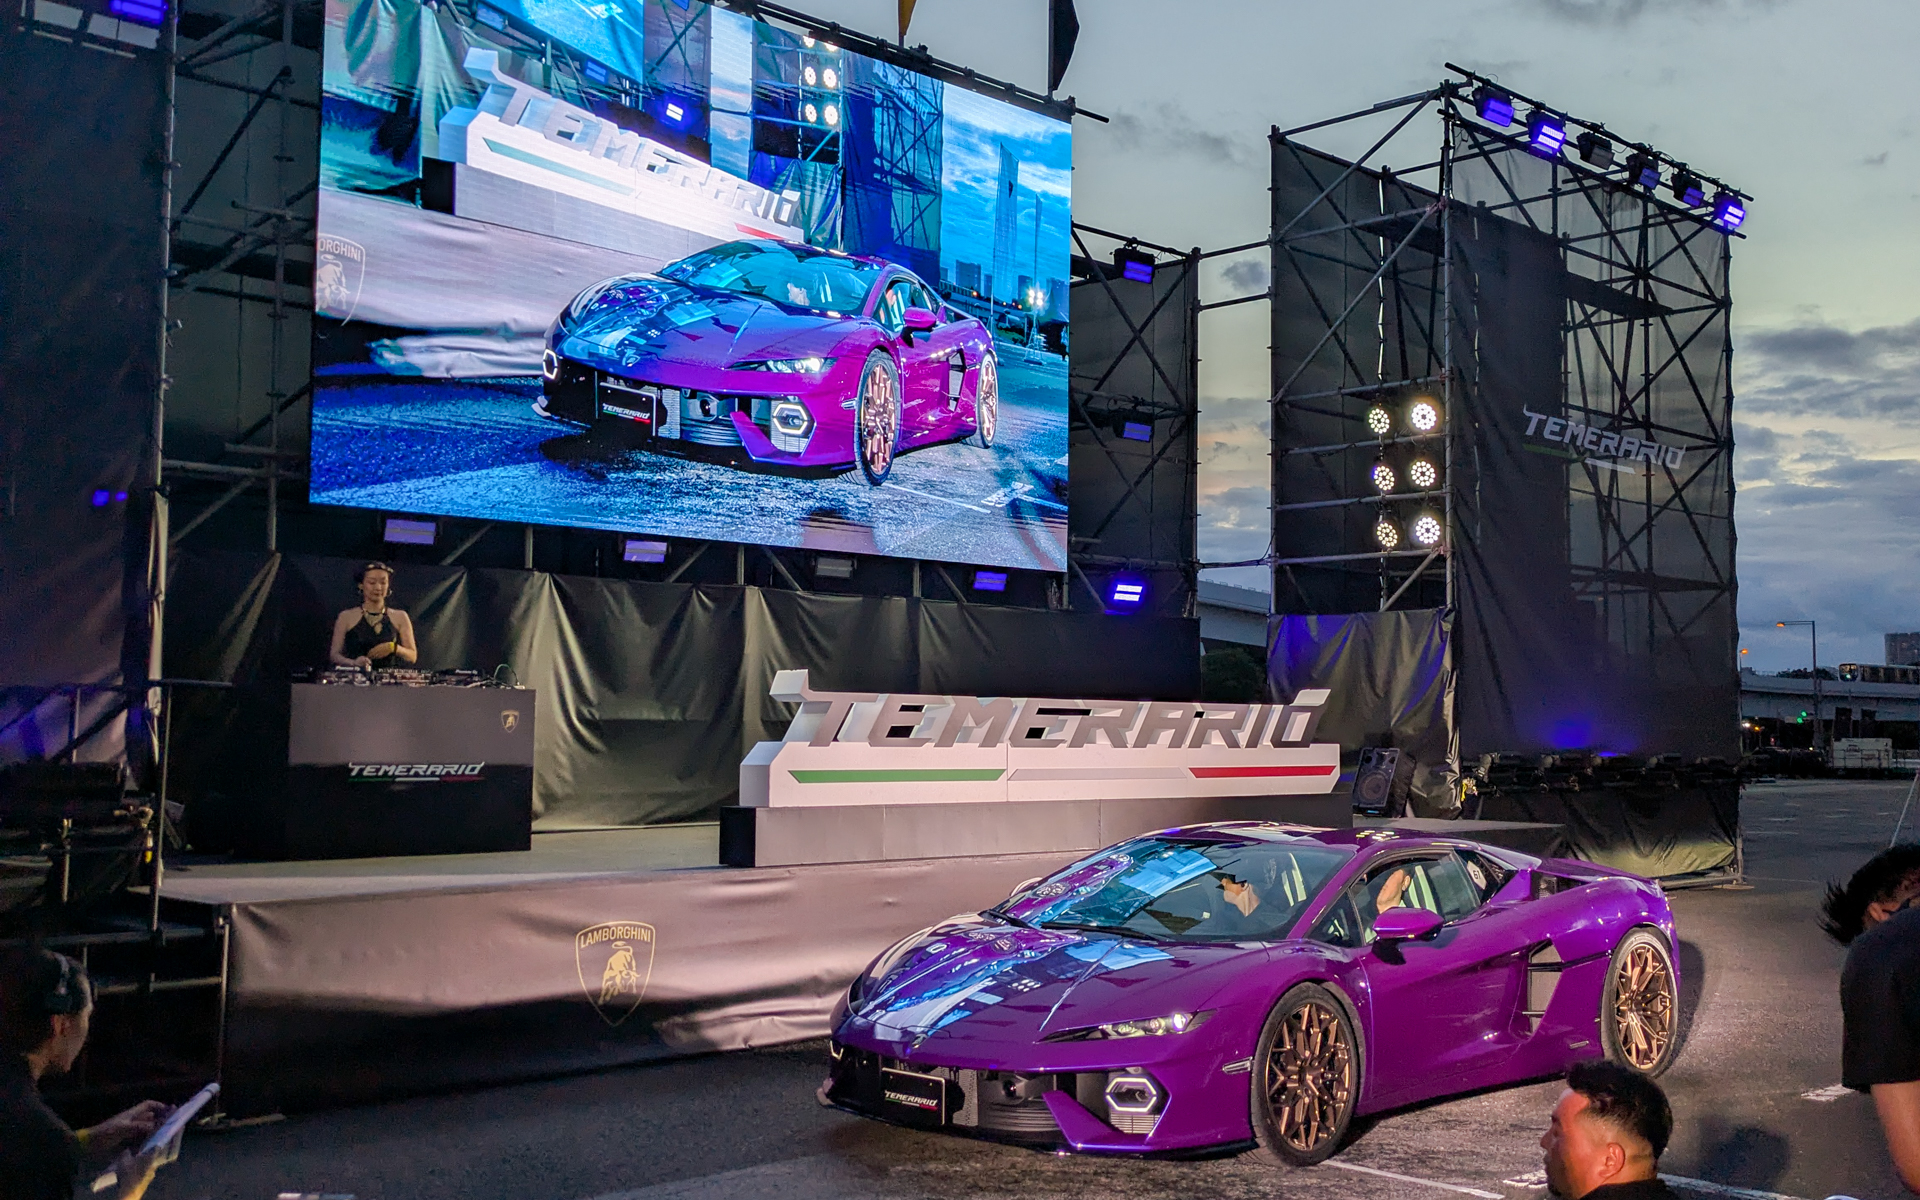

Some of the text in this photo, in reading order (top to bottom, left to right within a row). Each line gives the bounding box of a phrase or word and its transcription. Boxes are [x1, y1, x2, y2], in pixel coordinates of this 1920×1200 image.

[466, 47, 801, 227] TEMERARIO
[602, 403, 650, 419] TEMERARIO
[1523, 403, 1687, 469] TEMERARIO
[770, 669, 1331, 749] TEMERARIO
[349, 761, 485, 776] TEMERARIO
[580, 926, 651, 948] LAMBORGHINI
[884, 1090, 938, 1106] TEMERARIO
